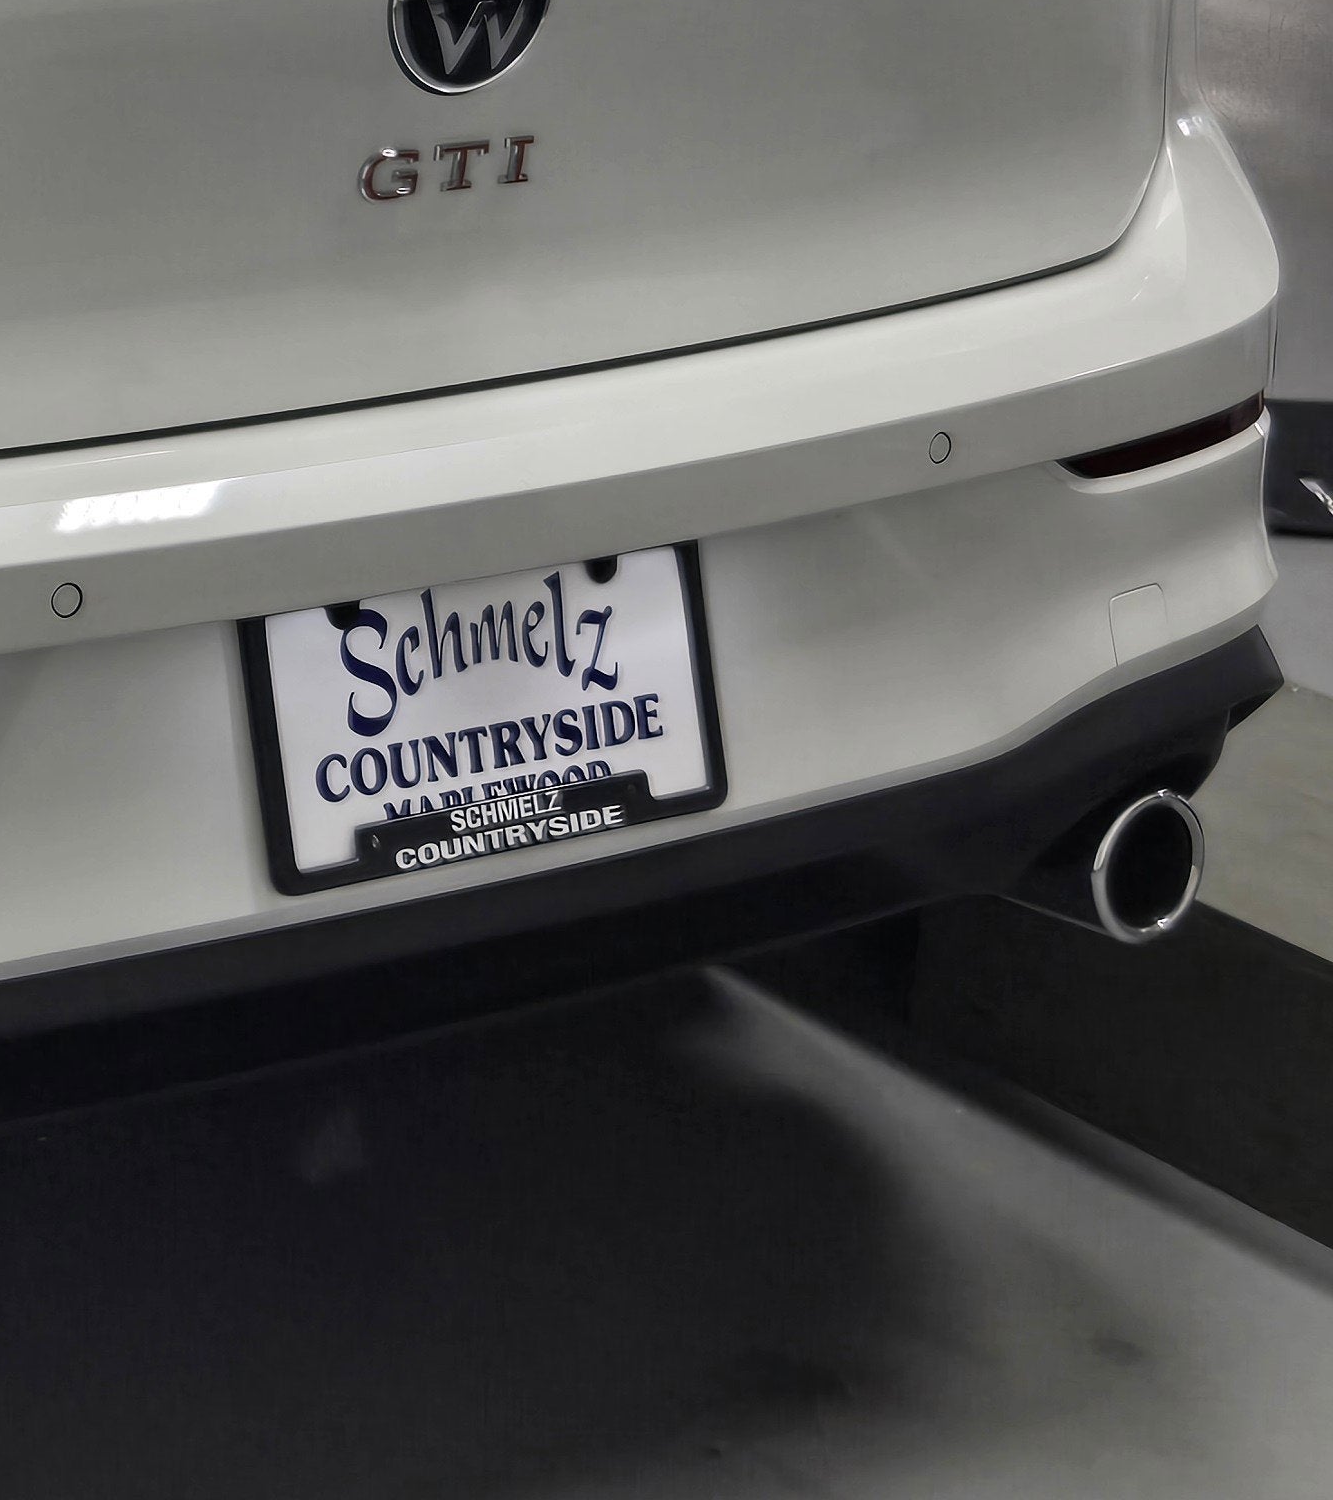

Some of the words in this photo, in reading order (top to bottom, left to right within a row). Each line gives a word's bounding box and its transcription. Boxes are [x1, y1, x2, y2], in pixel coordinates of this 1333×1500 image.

[357, 135, 535, 202] GTI
[339, 570, 619, 738] Schmelz
[315, 693, 664, 803] COUNTRYSIDE
[394, 804, 624, 870] COUNTRYSIDE
[449, 789, 563, 833] SCHMELZ
